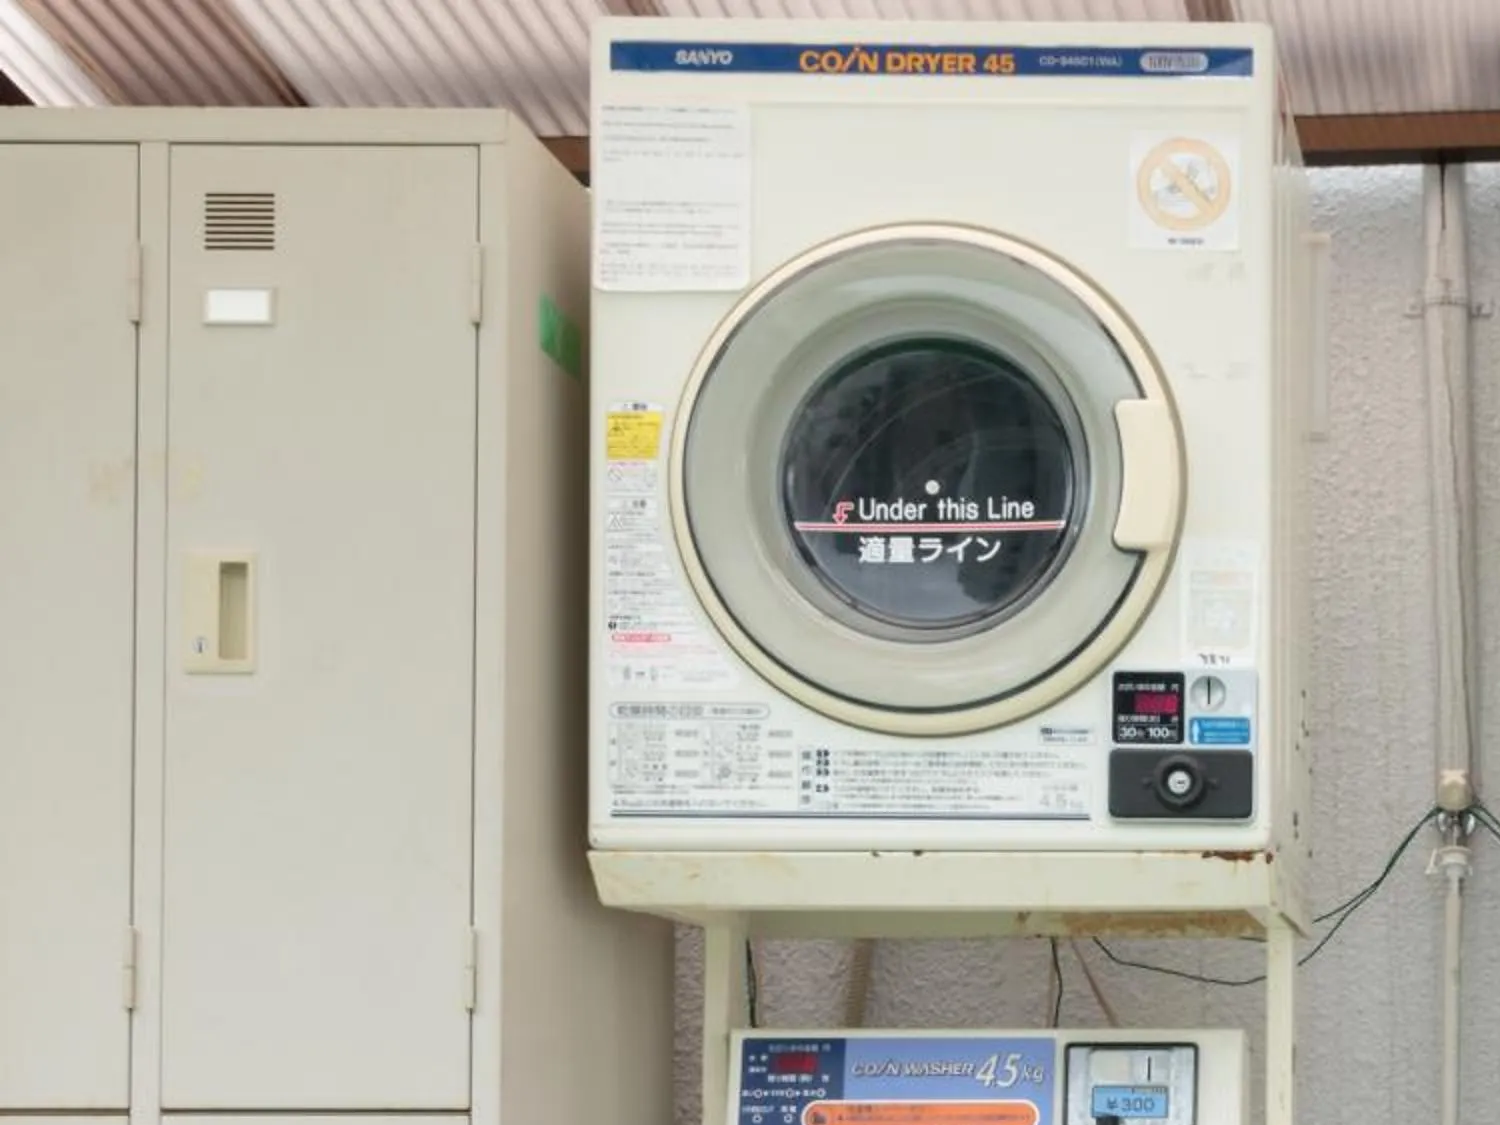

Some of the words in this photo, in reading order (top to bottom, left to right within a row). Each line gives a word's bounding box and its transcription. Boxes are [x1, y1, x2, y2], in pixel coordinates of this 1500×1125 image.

[675, 49, 734, 65] SANYO
[886, 51, 976, 72] DRYER
[983, 53, 1015, 73] 45
[859, 497, 927, 520] Under
[937, 497, 979, 520] this
[988, 495, 1035, 519] Line
[859, 536, 1001, 563] 適量ライン
[902, 1061, 974, 1077] WASHER
[1022, 1063, 1044, 1082] kg
